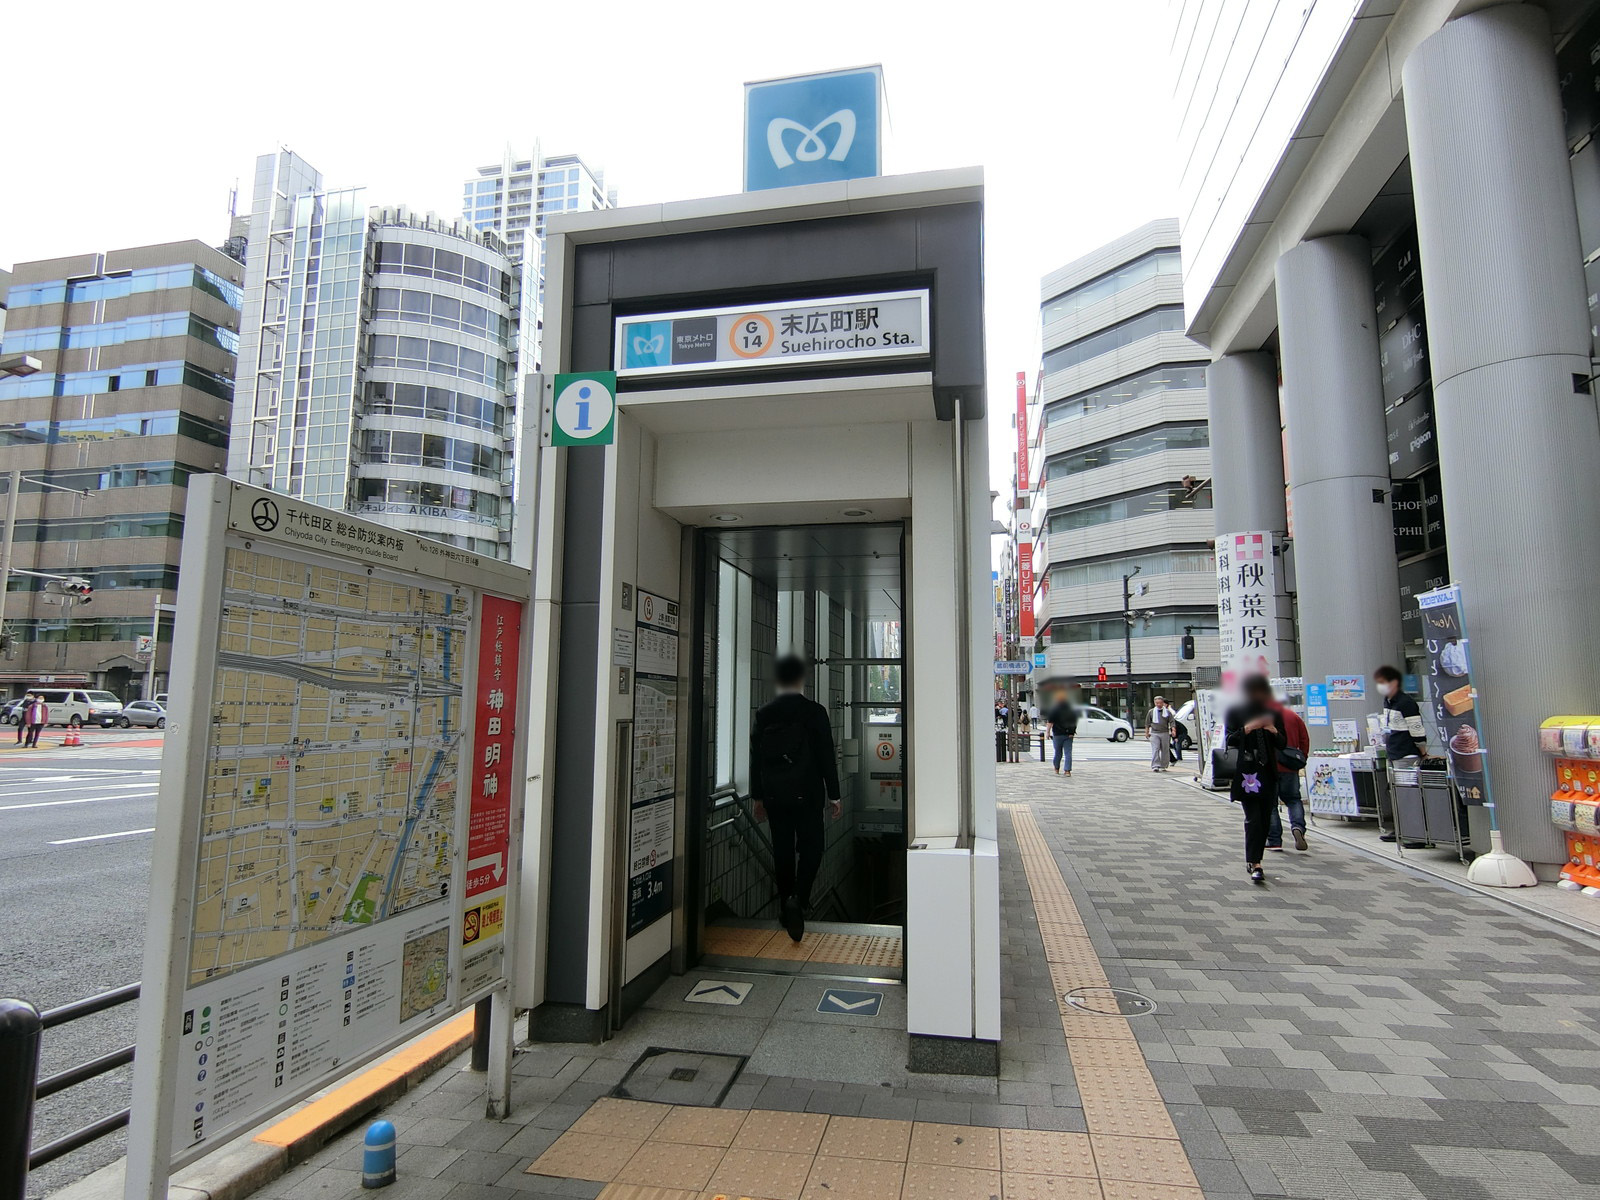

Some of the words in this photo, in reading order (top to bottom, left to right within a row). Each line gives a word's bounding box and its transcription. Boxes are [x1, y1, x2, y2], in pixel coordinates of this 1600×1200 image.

[745, 321, 758, 334] G
[780, 306, 879, 337] 末広町駅
[676, 333, 714, 344] 東京メトロ
[743, 335, 763, 349] 14
[781, 334, 877, 354] Suehirocho
[881, 331, 915, 347] Sta.
[1401, 322, 1421, 349] DHC
[1409, 430, 1432, 453] pigeon
[357, 503, 403, 514] アキュレイト
[409, 506, 449, 518] AKIBA
[286, 508, 333, 532] 千代田区
[336, 521, 405, 552] 総合防災案内板
[284, 526, 314, 543] Chiyoda
[314, 533, 328, 546] City
[331, 537, 365, 555] Emergency
[365, 546, 382, 558] Guide
[382, 549, 399, 562] Board
[1021, 552, 1032, 613] 三菱UFJ銀行
[1237, 563, 1270, 649] 秋葉原
[482, 687, 505, 800] 神田明神
[466, 873, 491, 891] 徒歩5分
[647, 880, 663, 899] 3.4m
